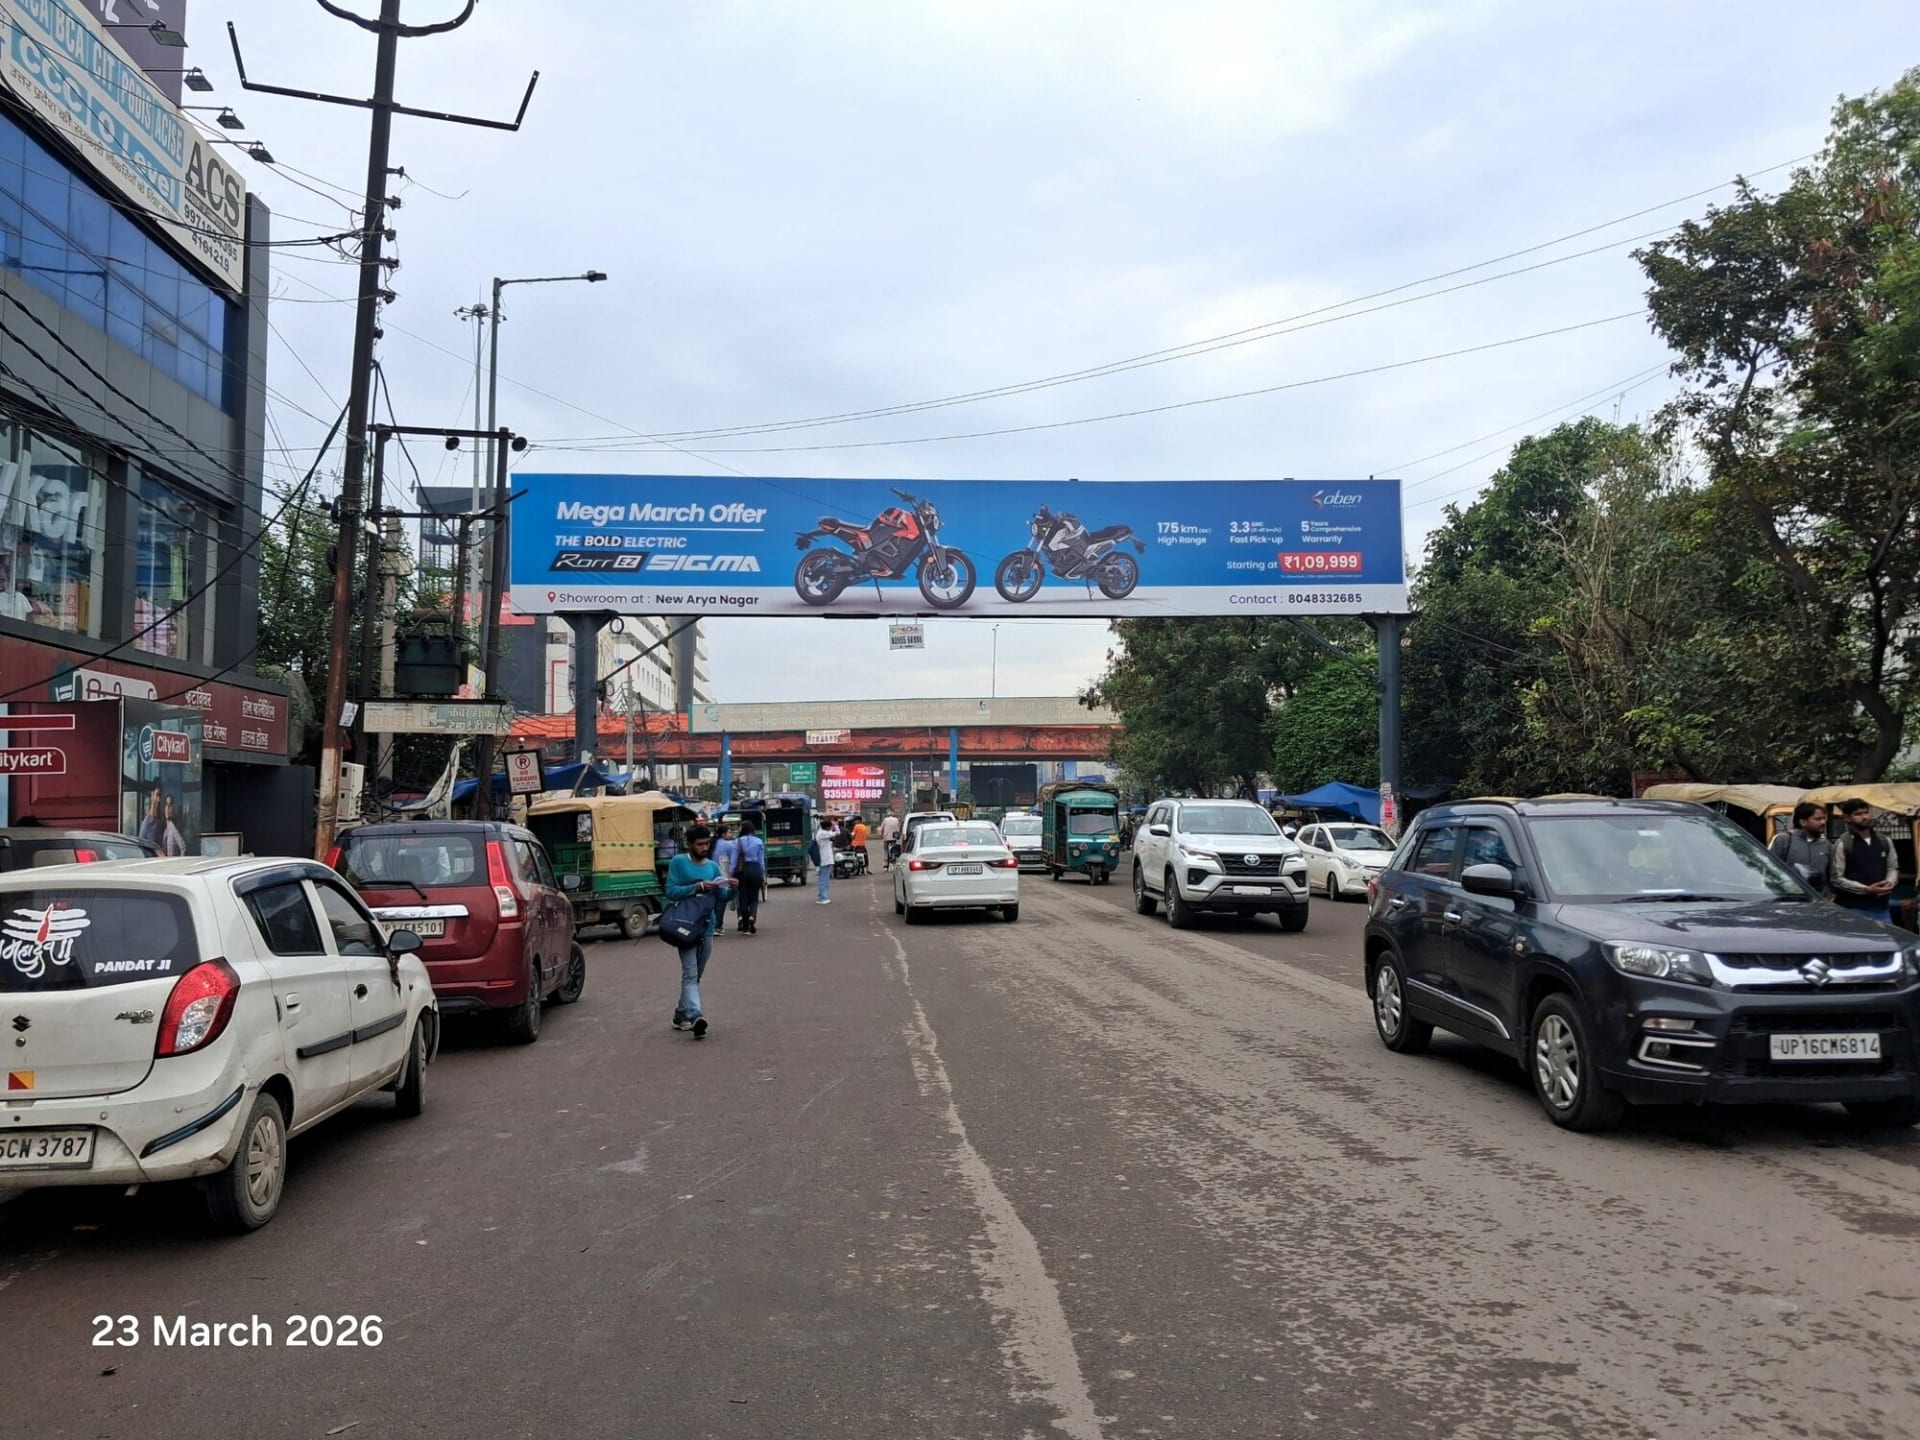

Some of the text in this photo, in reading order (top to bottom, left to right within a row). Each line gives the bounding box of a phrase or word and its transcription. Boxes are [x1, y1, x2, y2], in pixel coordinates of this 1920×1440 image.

[55, 3, 85, 64] BCA
[19, 35, 83, 112] CCC
[121, 131, 175, 204] Level
[185, 141, 240, 227] ACS
[1323, 490, 1362, 504] oben
[557, 501, 767, 527] Mega March Offer
[1158, 522, 1179, 533] 175
[1181, 524, 1198, 533] km
[1230, 521, 1250, 533] 3.3
[1301, 521, 1310, 532] 5
[555, 535, 687, 548] THE BOLD ELECTRIC
[1158, 536, 1207, 546] High Range
[1230, 535, 1283, 544] Fast Pick-up
[1302, 535, 1342, 544] Warranty
[556, 553, 613, 568] Rorr
[646, 554, 761, 572] SIGMA
[1226, 556, 1358, 571] Starting at ₹1,09,999
[559, 593, 627, 603] Showroom
[631, 594, 644, 603] at
[655, 595, 684, 604] New
[687, 595, 717, 607] Arya
[720, 595, 760, 607] Nagar
[1229, 595, 1278, 604] Contact
[1288, 593, 1362, 603] 8048332685
[156, 735, 186, 757] Citykart
[822, 779, 886, 787] ADVERTISE HERE
[824, 789, 853, 798] 93555
[95, 960, 172, 973] PANDAT JI
[1780, 1038, 1879, 1055] UP16CM6814
[36, 1137, 87, 1157] 3787
